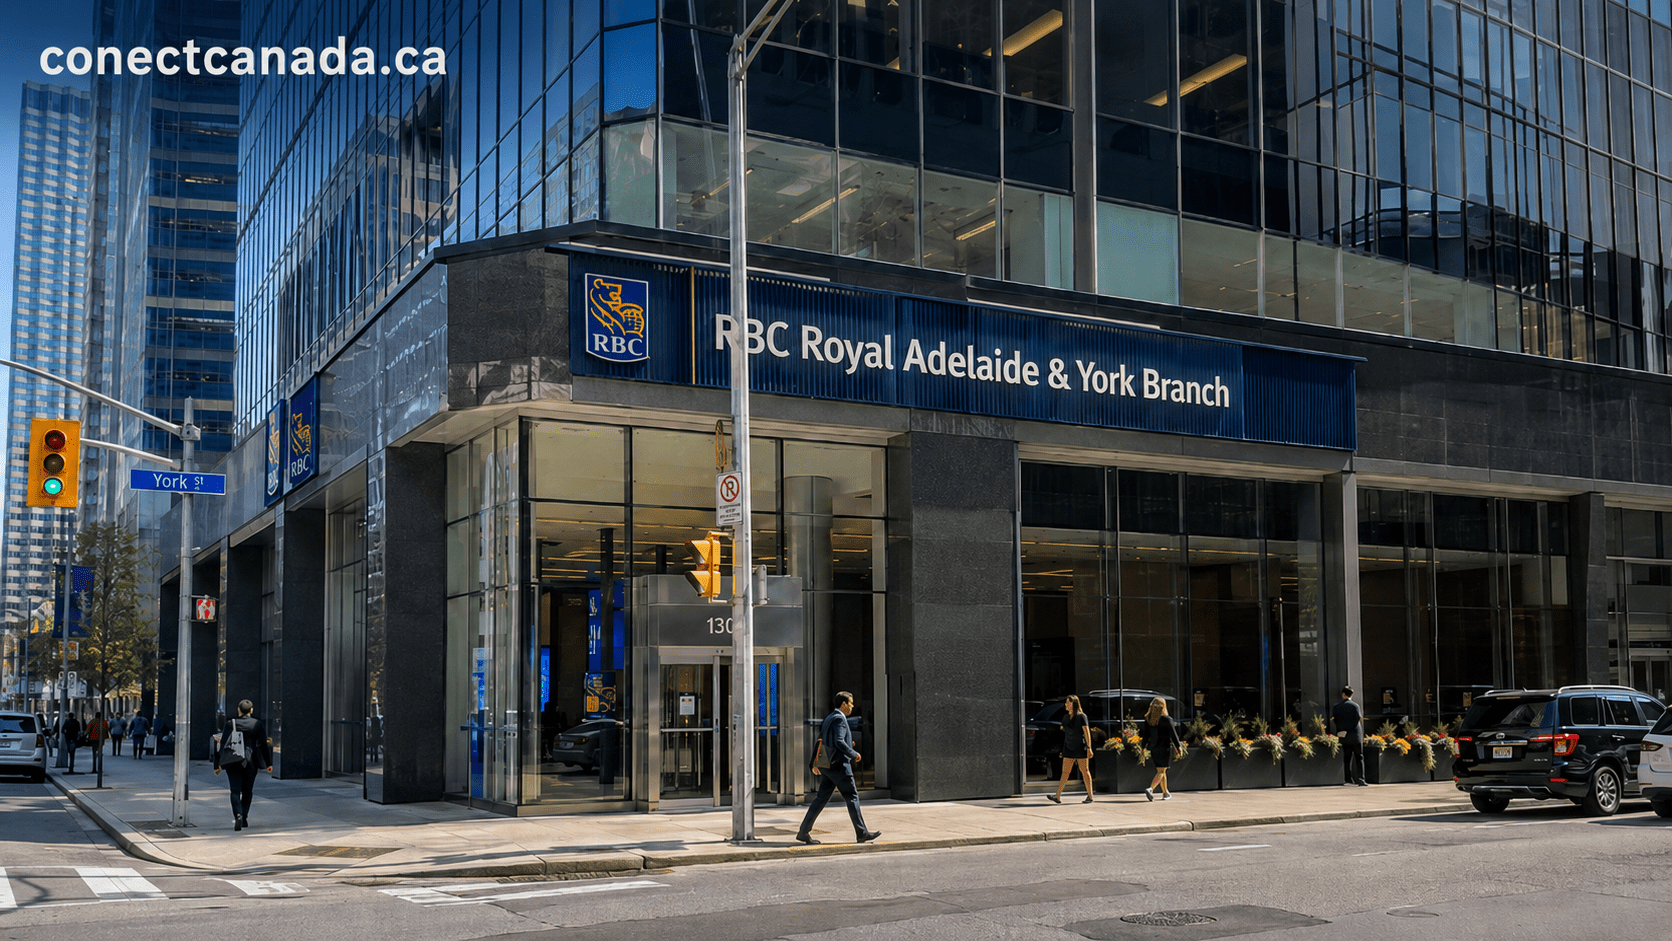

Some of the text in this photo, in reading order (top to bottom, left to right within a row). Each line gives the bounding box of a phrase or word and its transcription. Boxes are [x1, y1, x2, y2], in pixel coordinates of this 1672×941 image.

[592, 333, 643, 356] RBC
[715, 313, 1230, 408] RBC Royal Adelaide & York Branch
[290, 454, 310, 478] RBC
[153, 473, 204, 489] York St
[706, 617, 734, 634] 130
